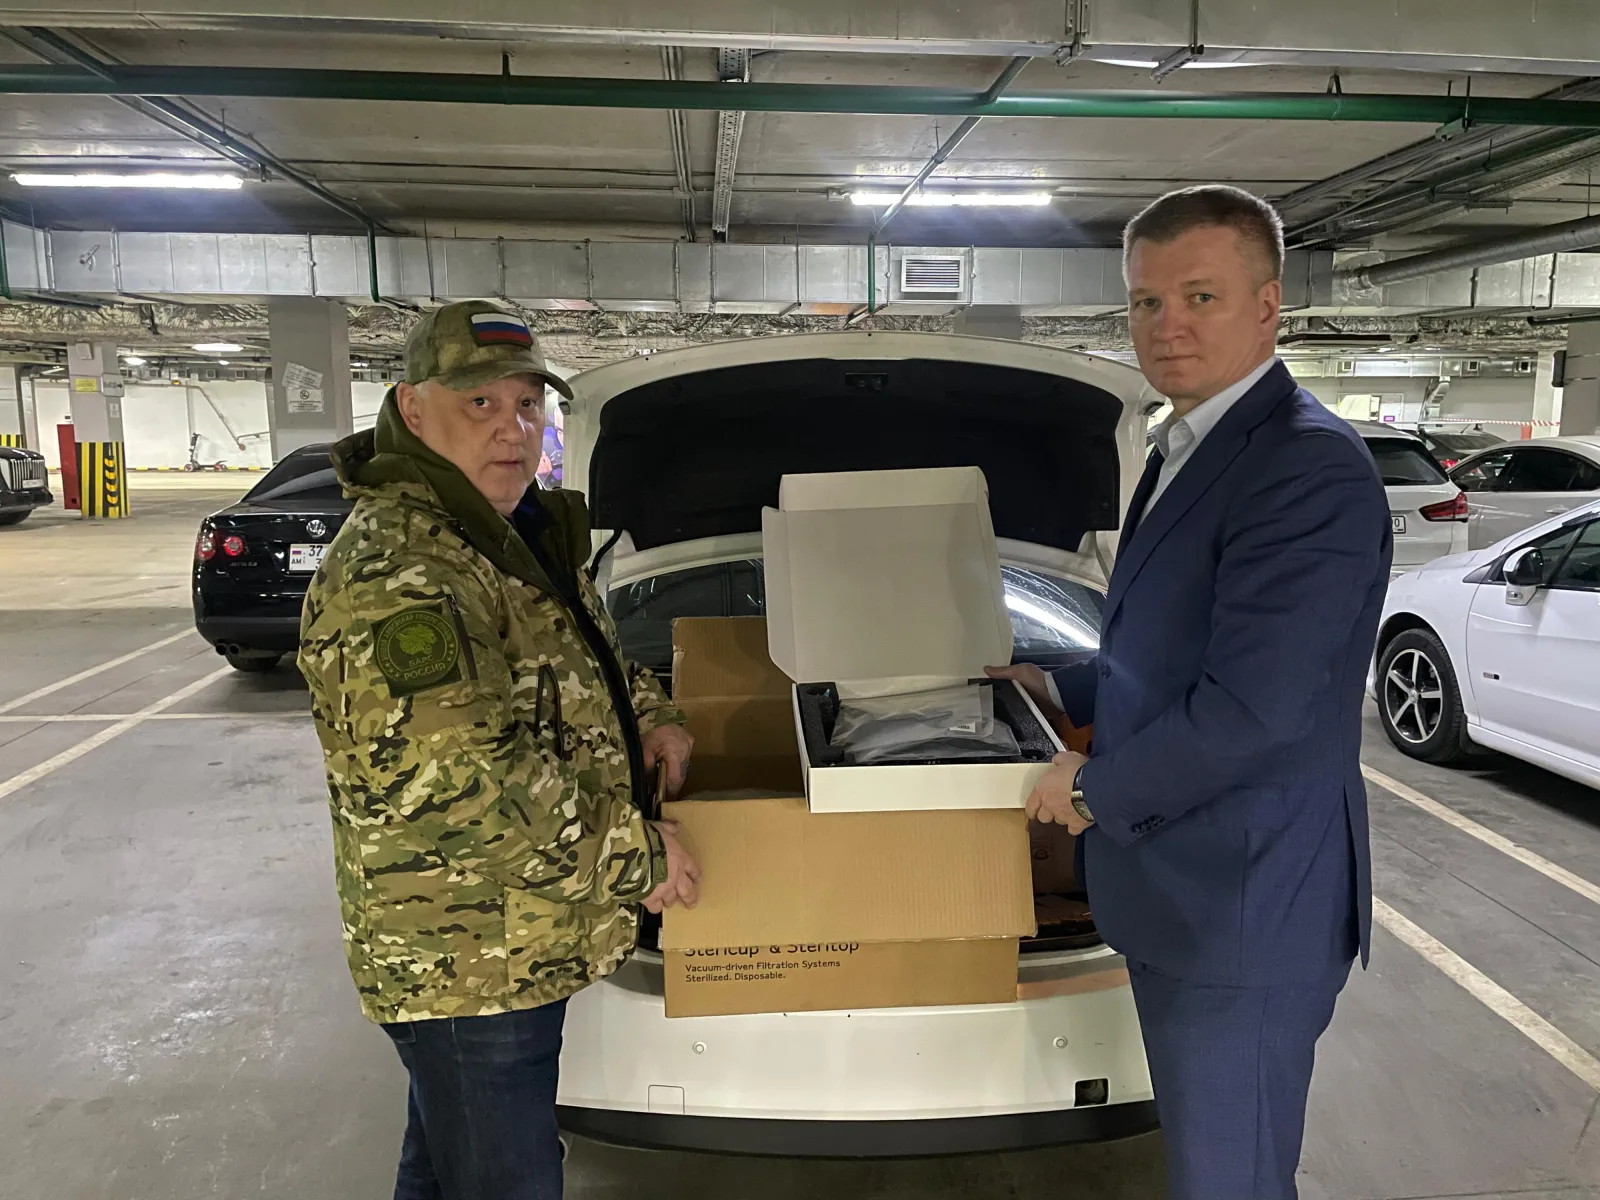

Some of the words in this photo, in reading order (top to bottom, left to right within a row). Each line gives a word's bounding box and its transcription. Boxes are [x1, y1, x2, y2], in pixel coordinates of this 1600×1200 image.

[408, 654, 434, 667] БАРС
[403, 662, 446, 681] РОССИЯ
[769, 944, 781, 954] &
[685, 963, 754, 972] Vacuum-driven
[756, 961, 799, 970] Filtration
[801, 960, 841, 970] Systems
[685, 973, 732, 983] Sterilized.
[734, 971, 786, 982] Disposable.
